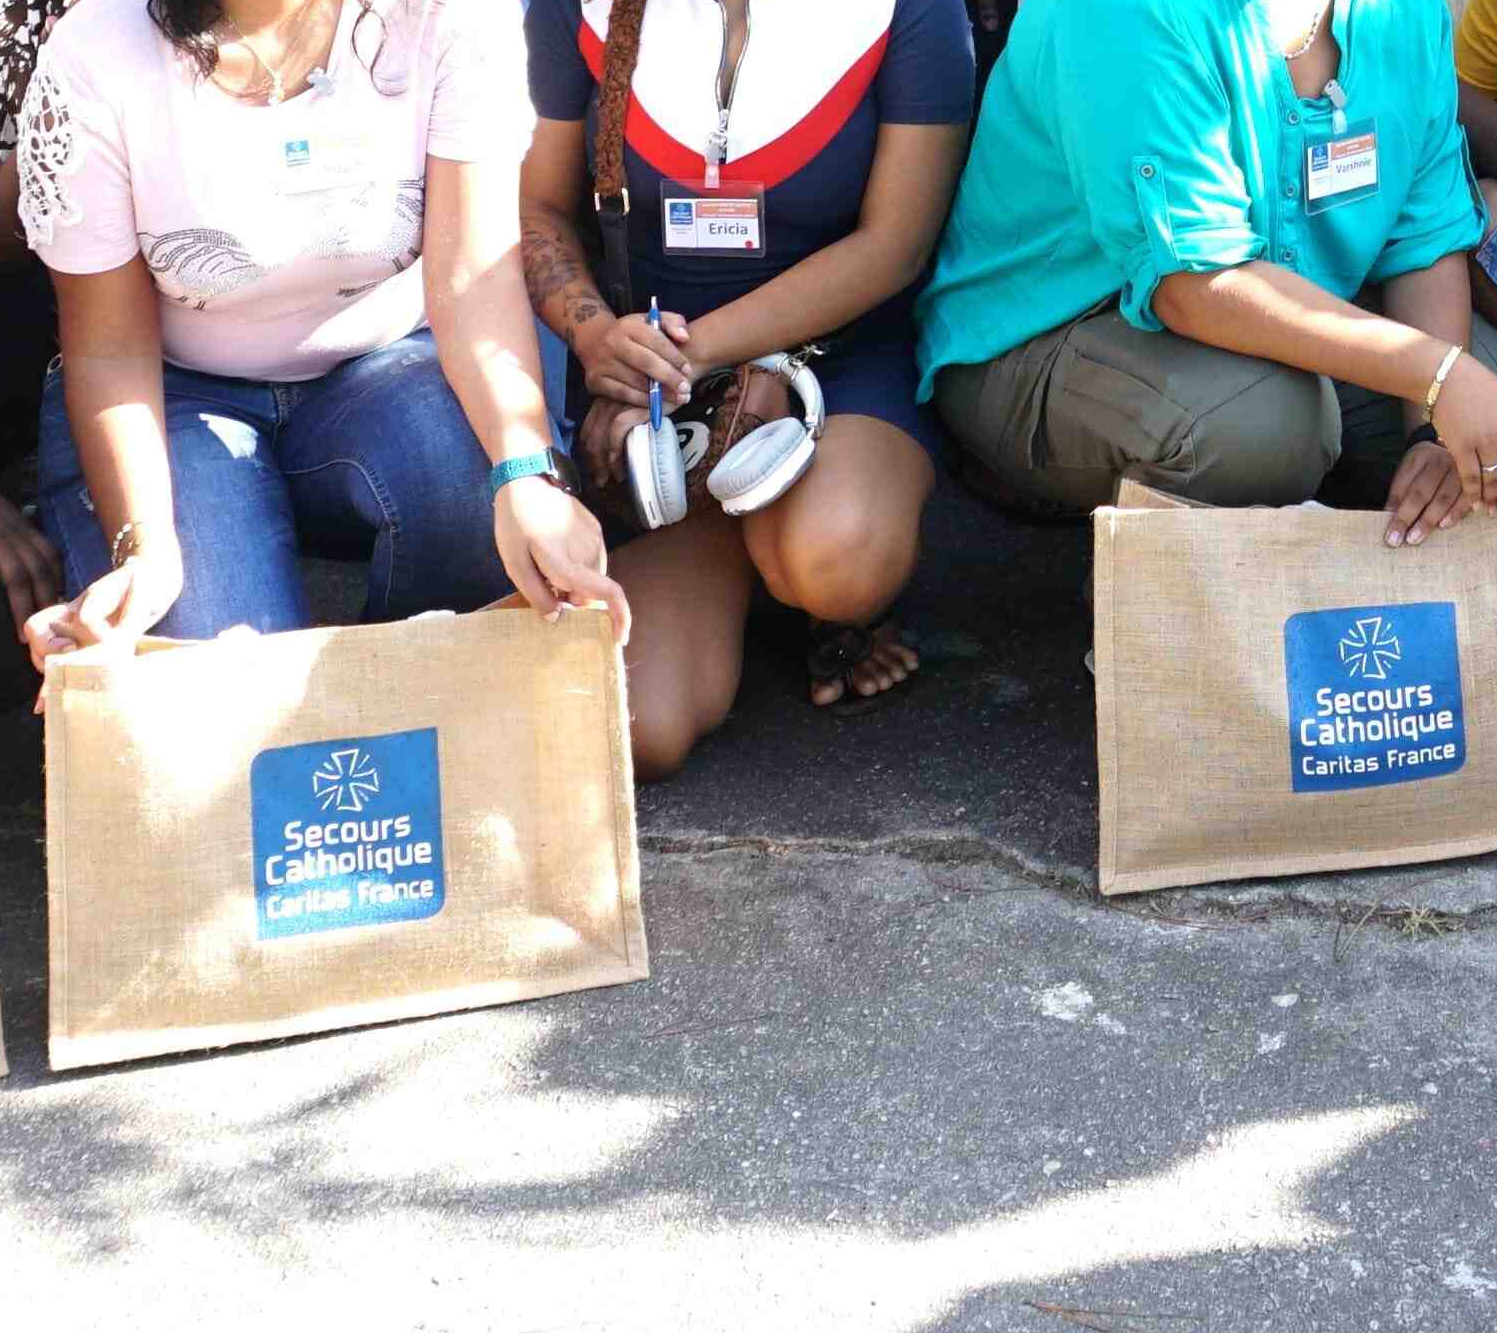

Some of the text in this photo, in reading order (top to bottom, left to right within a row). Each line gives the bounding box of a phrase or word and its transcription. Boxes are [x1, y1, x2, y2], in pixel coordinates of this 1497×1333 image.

[708, 221, 749, 235] Ericia
[1316, 684, 1433, 717] Secours
[1300, 709, 1454, 747] Catholique
[1302, 743, 1456, 776] Caritas France
[284, 814, 411, 852] Secours
[264, 841, 433, 886] Catholique
[265, 879, 434, 919] Caritas France
